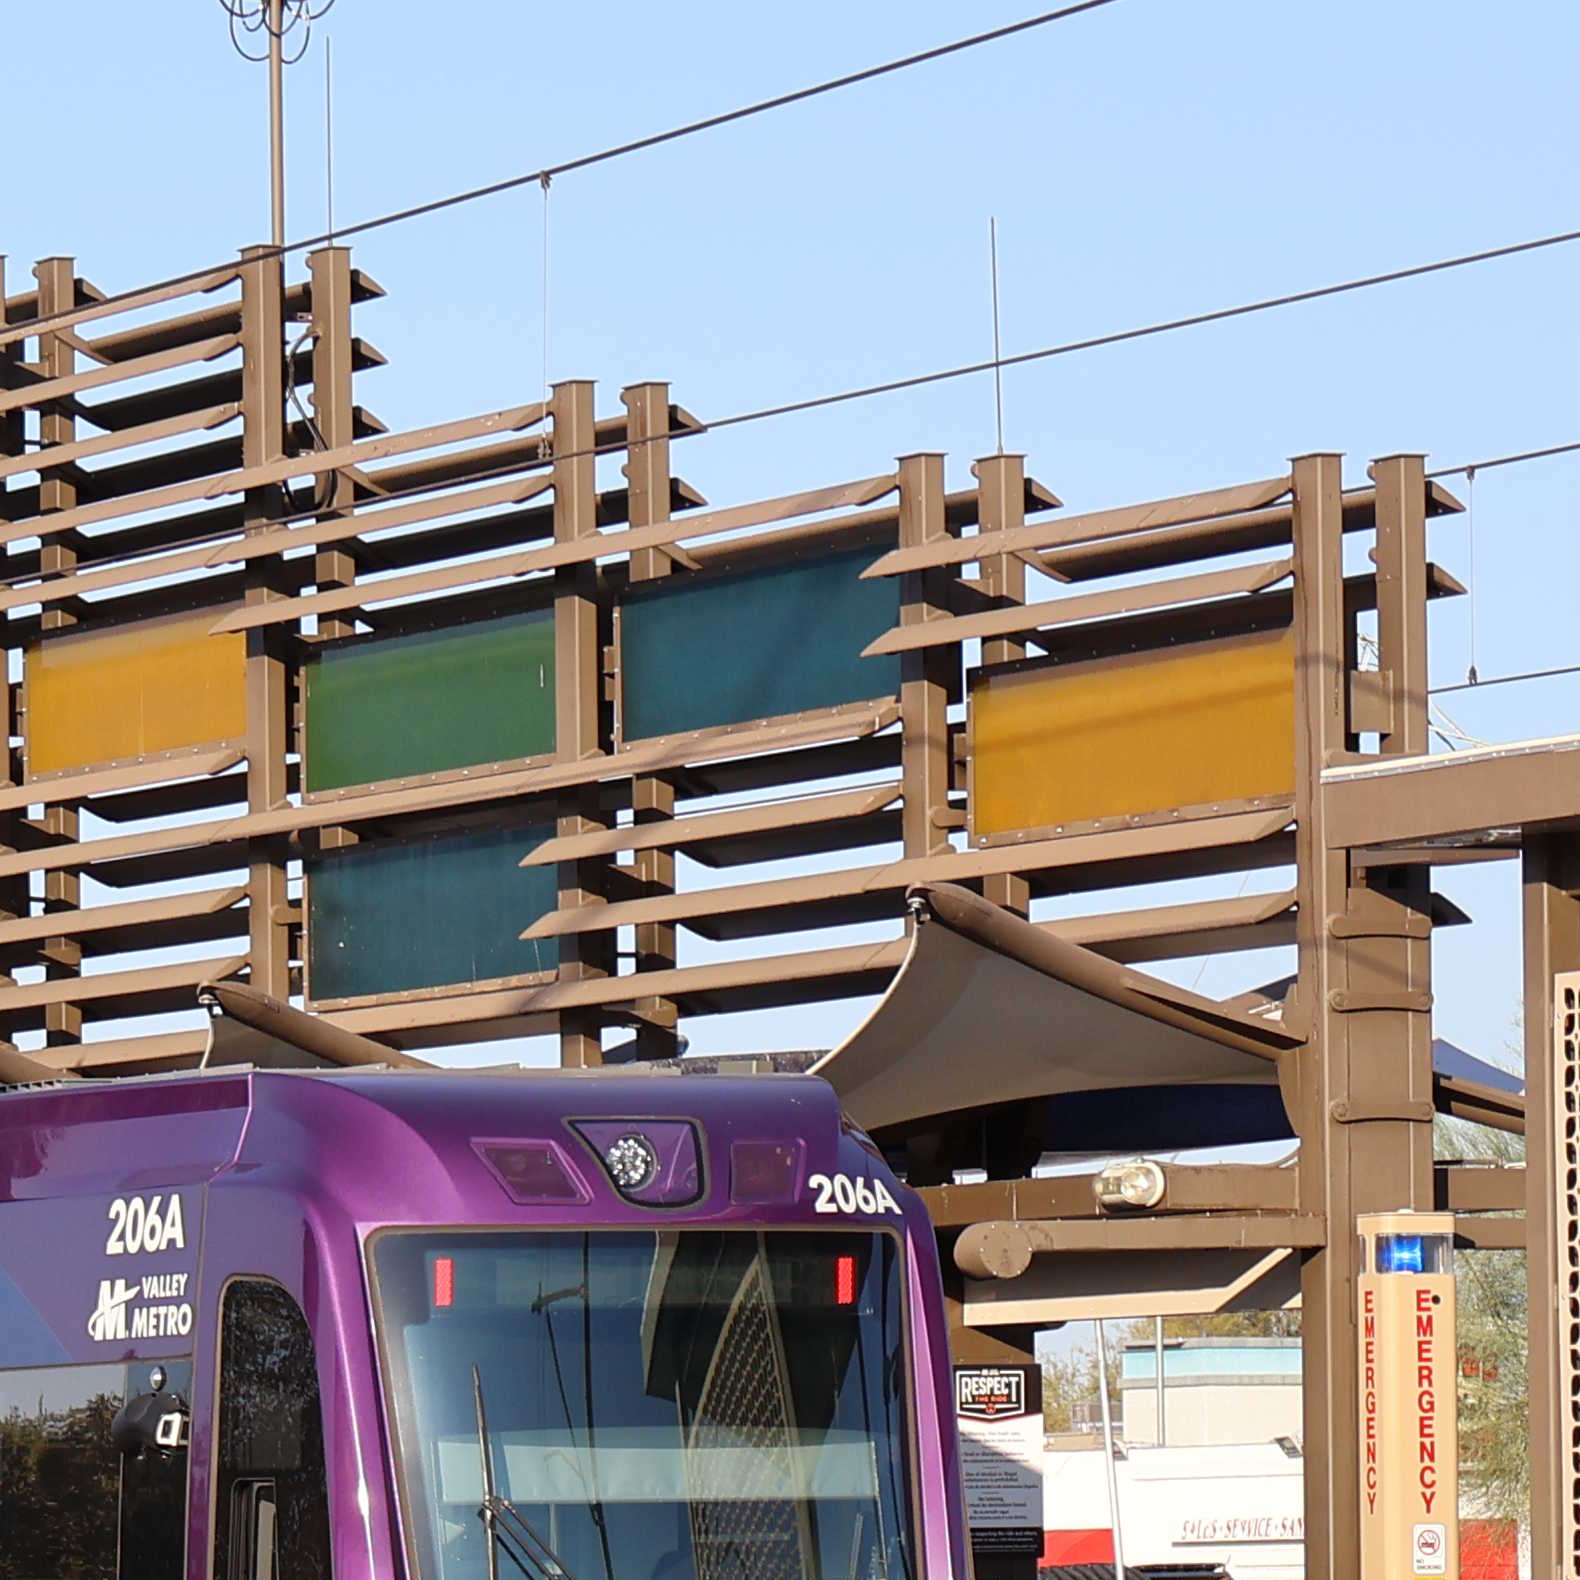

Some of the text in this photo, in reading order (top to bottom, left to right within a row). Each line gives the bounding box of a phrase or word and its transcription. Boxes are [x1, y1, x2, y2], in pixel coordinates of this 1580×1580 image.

[808, 1173, 903, 1215] 206A
[105, 1193, 185, 1255] 206A
[142, 1273, 188, 1299] VALLEY
[132, 1303, 193, 1339] METRO
[961, 1376, 1019, 1402] RESPECT
[1364, 1290, 1377, 1515] EMERGENCY
[1415, 1289, 1436, 1514] EMERGENCY
[1181, 1520, 1218, 1540] SALES
[1224, 1518, 1272, 1539] SERVICE
